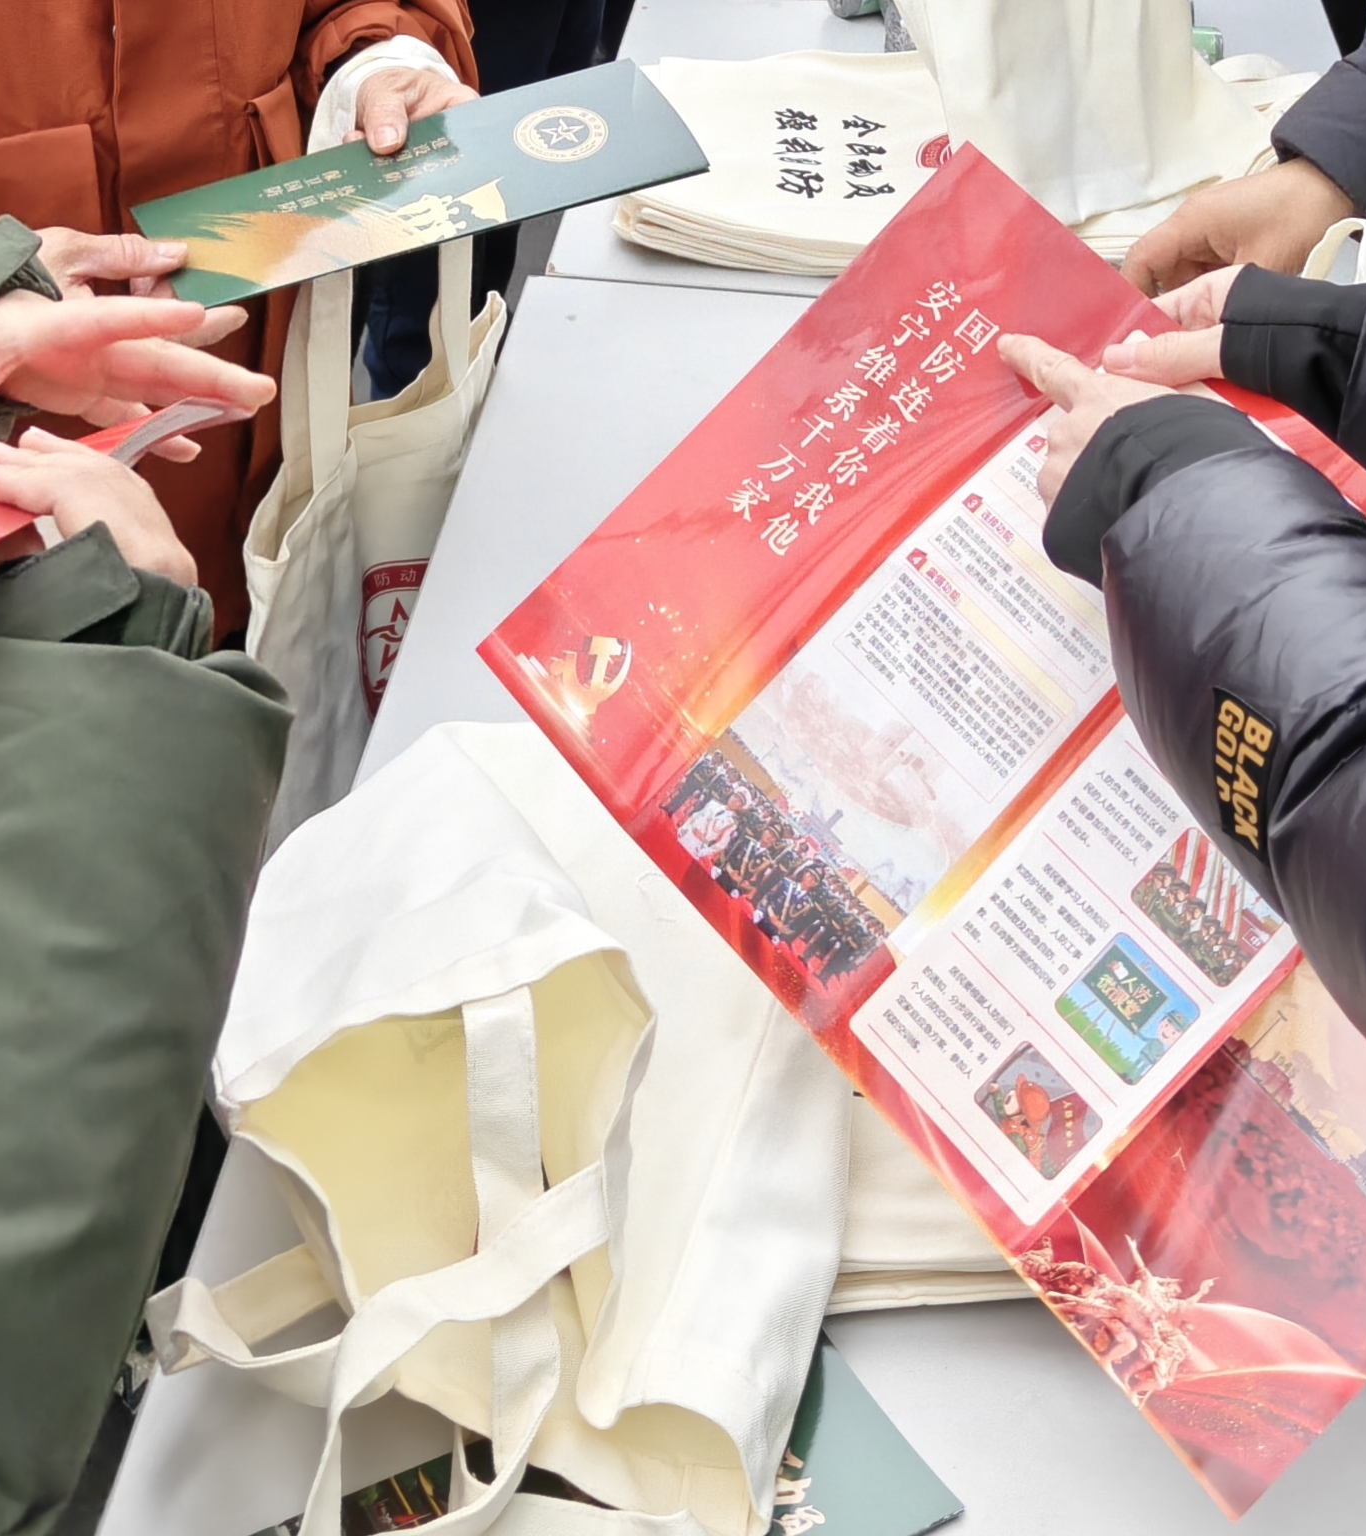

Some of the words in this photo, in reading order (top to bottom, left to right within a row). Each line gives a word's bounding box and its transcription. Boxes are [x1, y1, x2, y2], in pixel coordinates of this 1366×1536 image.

[263, 166, 343, 199] 保卫国防
[381, 152, 461, 185] 关心国防
[842, 115, 896, 200] 全民动员
[273, 182, 357, 215] 热爱国防
[725, 280, 963, 522] 安宁维系千万家
[759, 306, 1000, 559] 国防连着你我他
[1094, 767, 1167, 838] 人防负责人和社区居
[1122, 766, 1180, 824] 要明确战时社区
[1233, 717, 1274, 852] BLACK
[1055, 809, 1094, 848] 防专业队。
[1068, 795, 1141, 867] 积极参加市或社区人
[1040, 861, 1111, 933] 居民要学习人防知识
[961, 919, 985, 944] 技能。
[947, 964, 1016, 1036] 居民要根据人防部门
[1094, 971, 1143, 1023] 微课堂
[1119, 971, 1155, 1007] 人防
